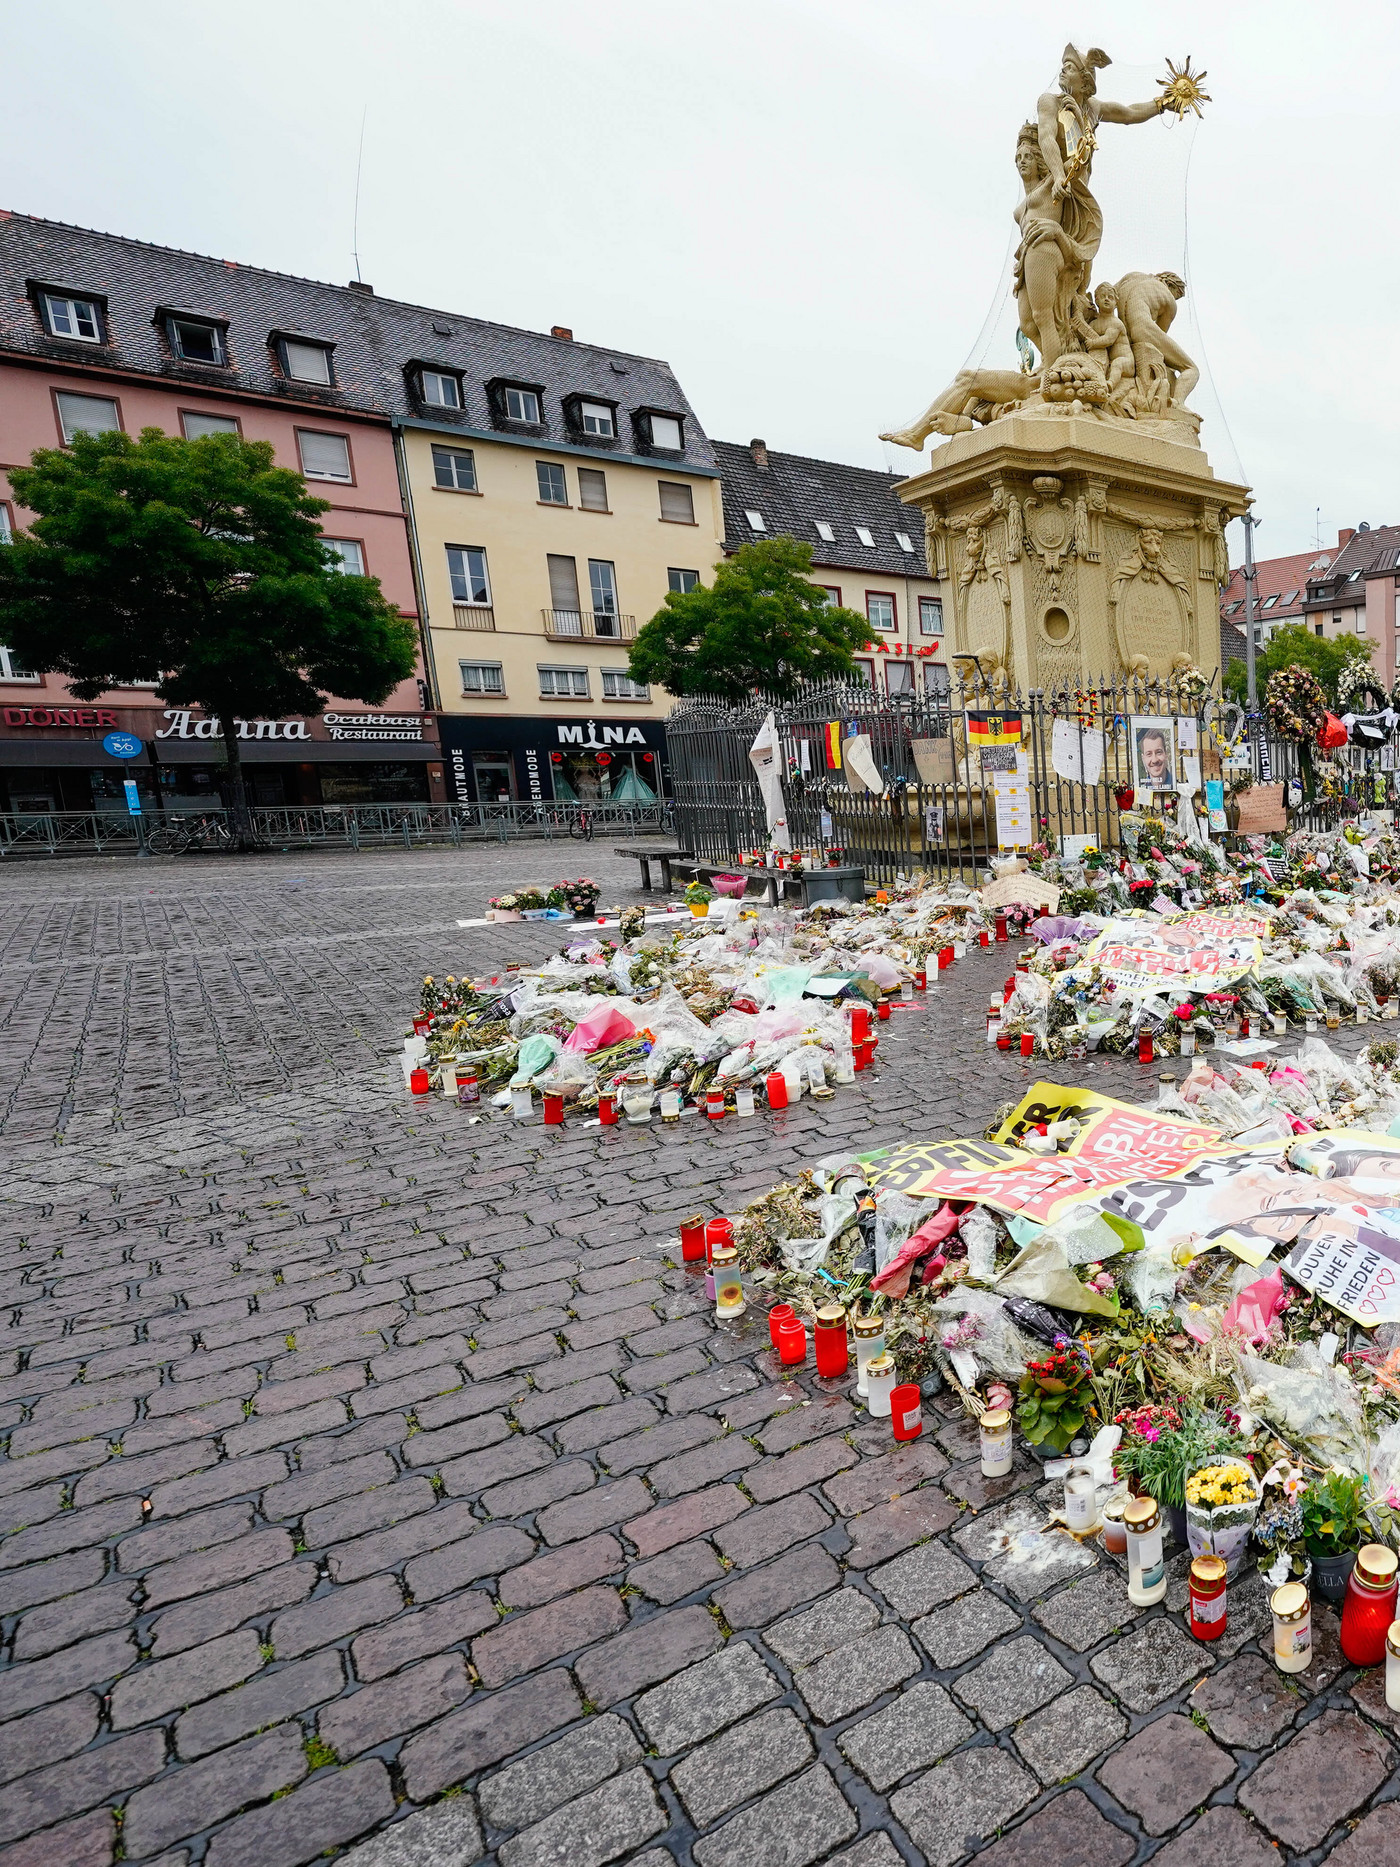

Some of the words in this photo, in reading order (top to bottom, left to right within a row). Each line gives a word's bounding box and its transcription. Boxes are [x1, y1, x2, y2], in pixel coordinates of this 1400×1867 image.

[3, 705, 118, 727] DÖNER
[330, 728, 423, 740] Restaurant
[1316, 1256, 1348, 1298] RUHE
[1336, 1251, 1380, 1311] FRIEDEN
